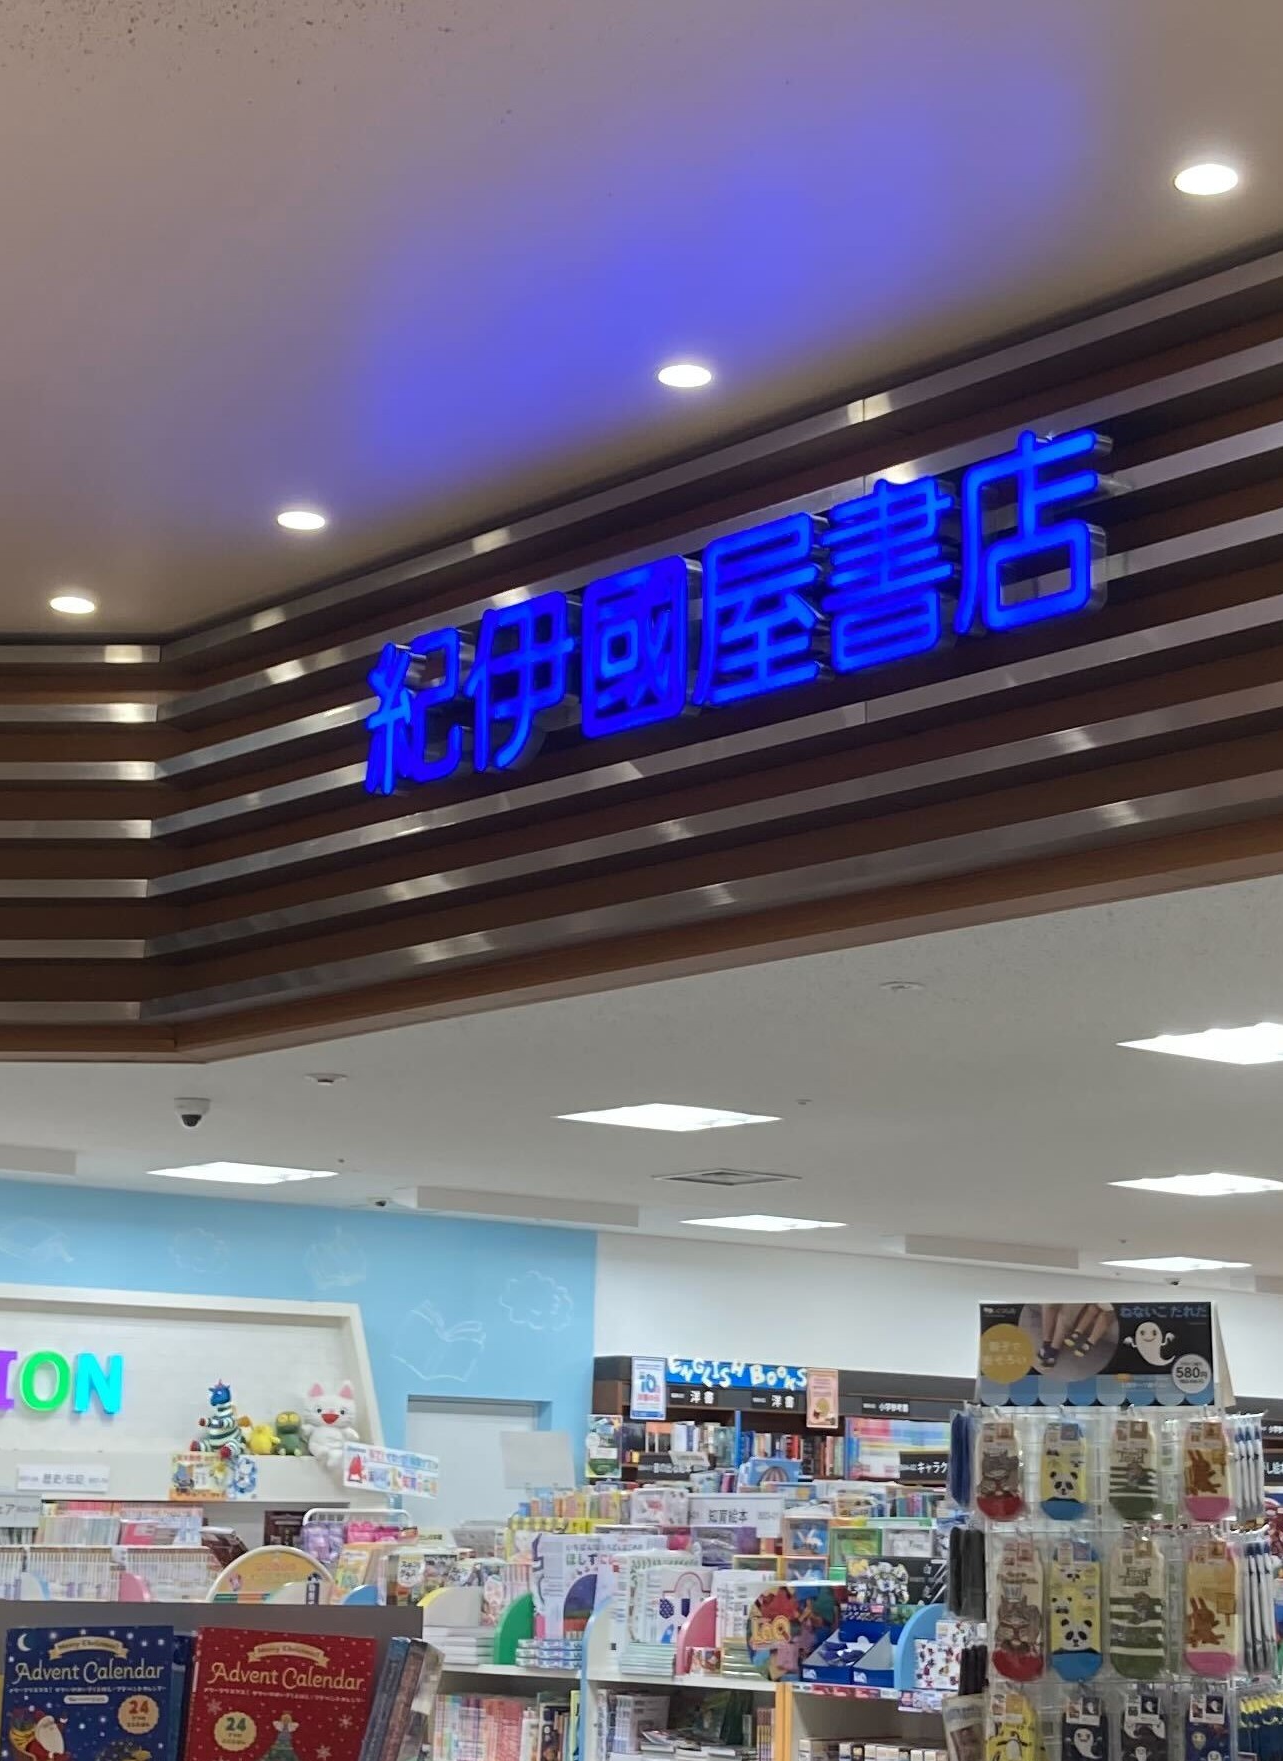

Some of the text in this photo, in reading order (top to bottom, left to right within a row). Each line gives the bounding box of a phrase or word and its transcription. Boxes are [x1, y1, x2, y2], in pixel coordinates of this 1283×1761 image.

[364, 429, 1106, 797] 紀伊國屋書店
[11, 1657, 165, 1685] Advent Calendar
[207, 1662, 366, 1691] Advent Calendar
[128, 1700, 150, 1715] 24
[225, 1717, 247, 1731] 24
